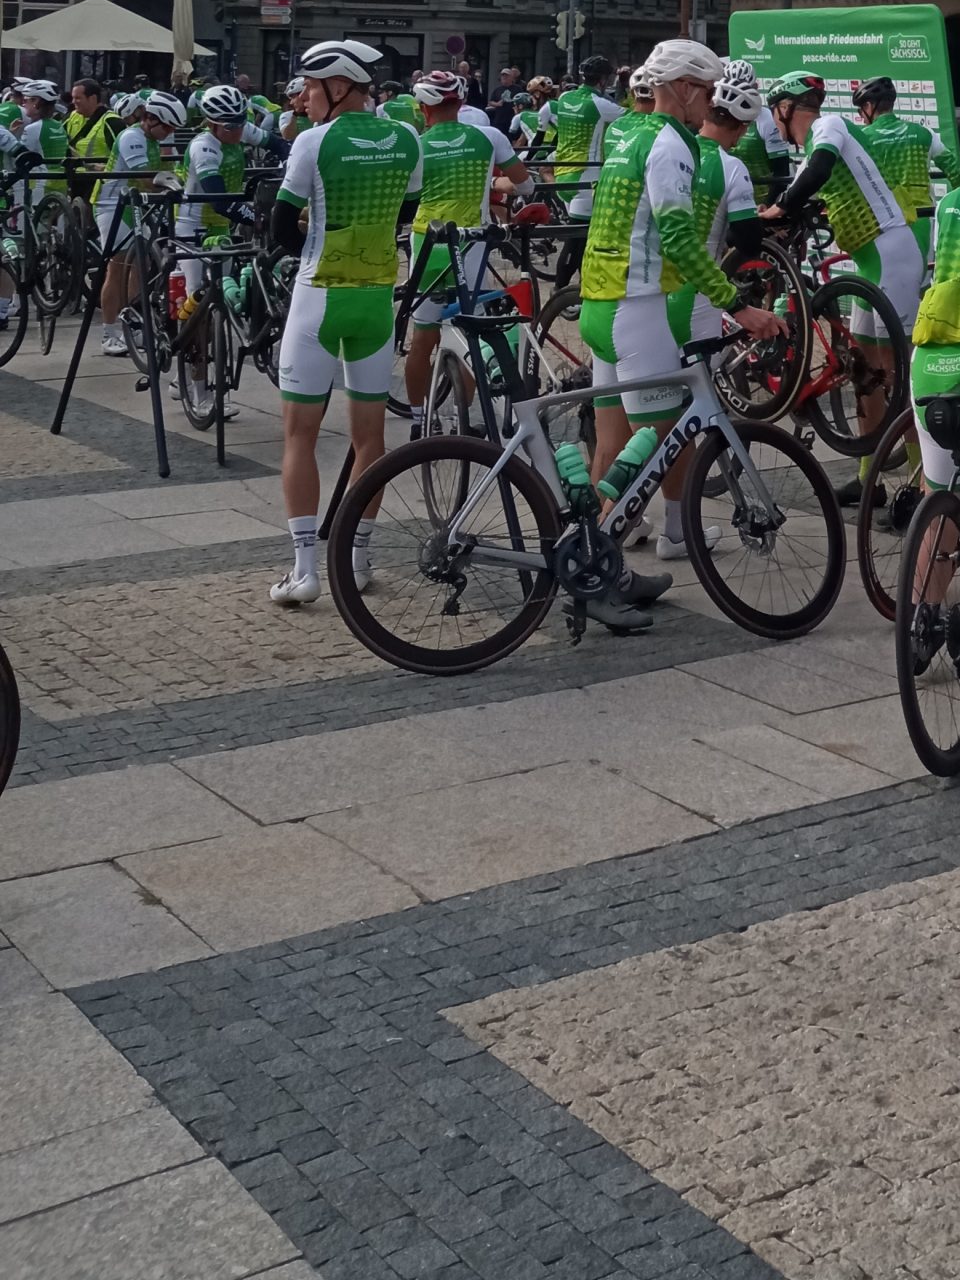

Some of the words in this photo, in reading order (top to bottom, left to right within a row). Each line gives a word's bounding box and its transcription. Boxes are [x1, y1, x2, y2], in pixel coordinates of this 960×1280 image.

[774, 34, 828, 45] Internationale
[829, 33, 883, 45] Friedensfahrt
[899, 40, 906, 48] SO
[907, 39, 921, 48] GEHT
[802, 53, 858, 64] peace-ride.com
[609, 415, 702, 540] cervélo
